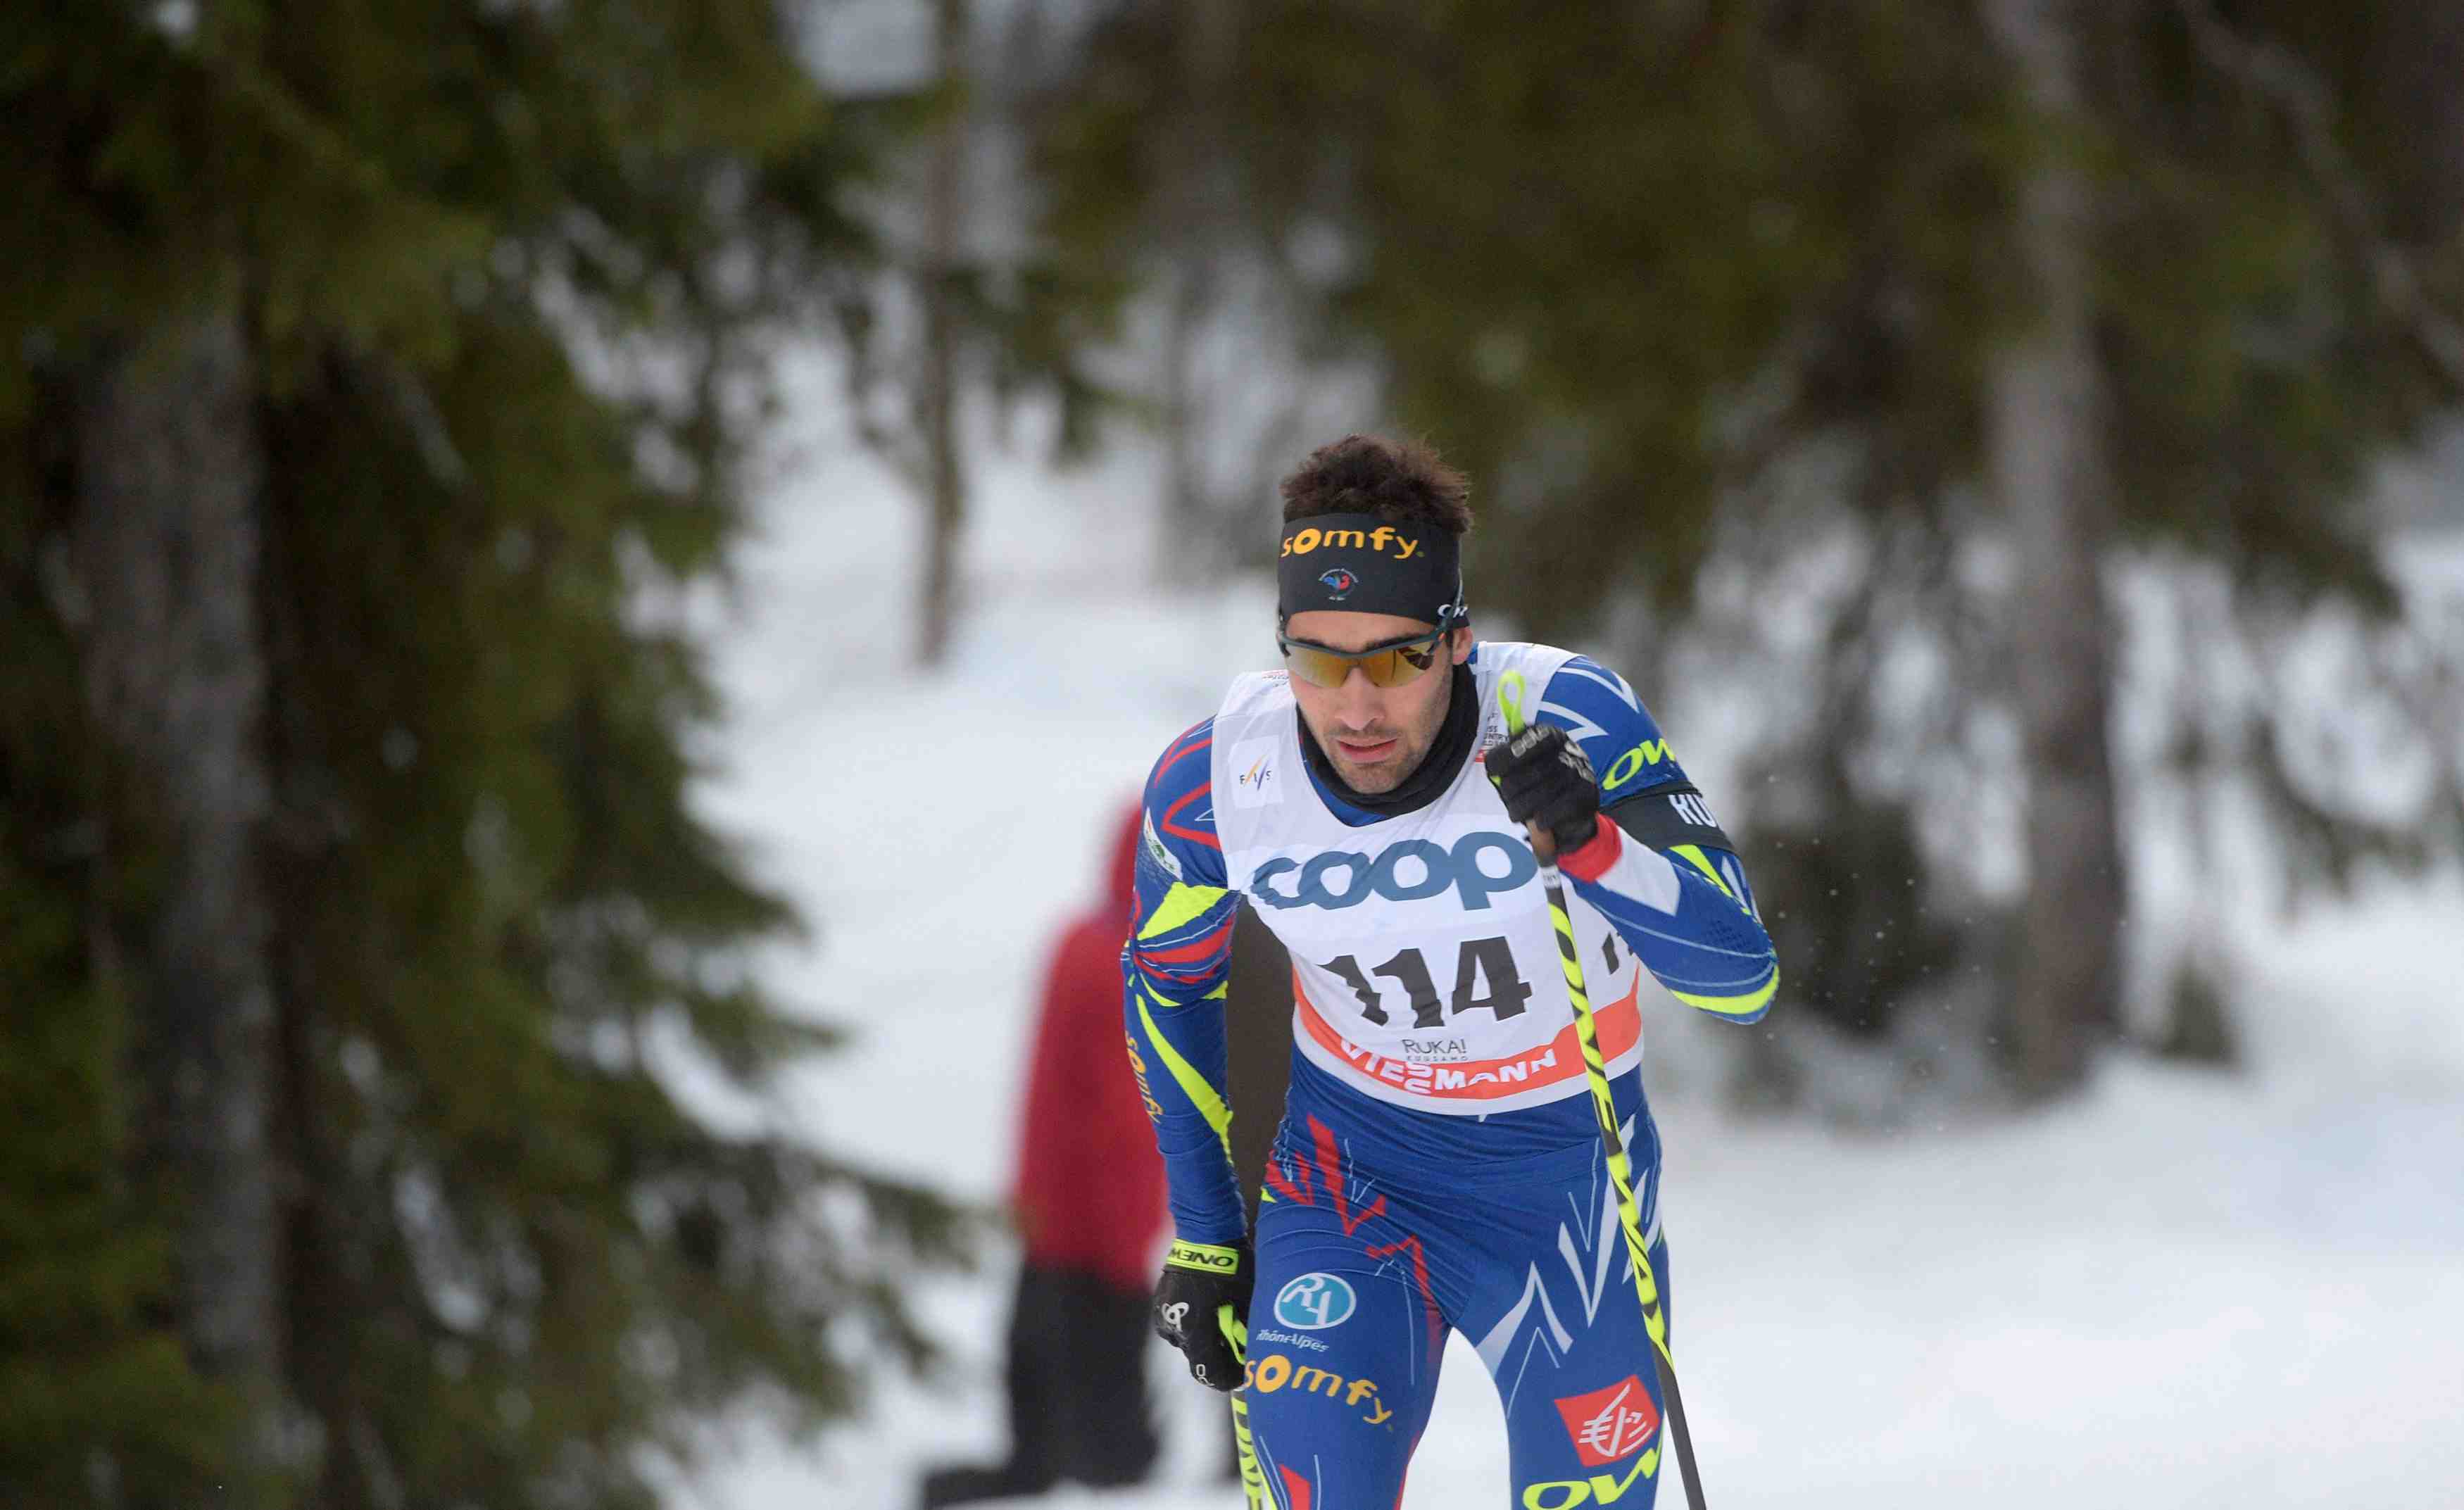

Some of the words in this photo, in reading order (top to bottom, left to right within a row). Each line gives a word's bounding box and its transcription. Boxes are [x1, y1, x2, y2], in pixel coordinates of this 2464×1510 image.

[1279, 526, 1420, 560] somfy
[1250, 831, 1538, 911] coop
[1316, 936, 1533, 1029] 114
[1400, 1038, 1467, 1054] RUKA!
[1244, 1354, 1394, 1426] somfy
